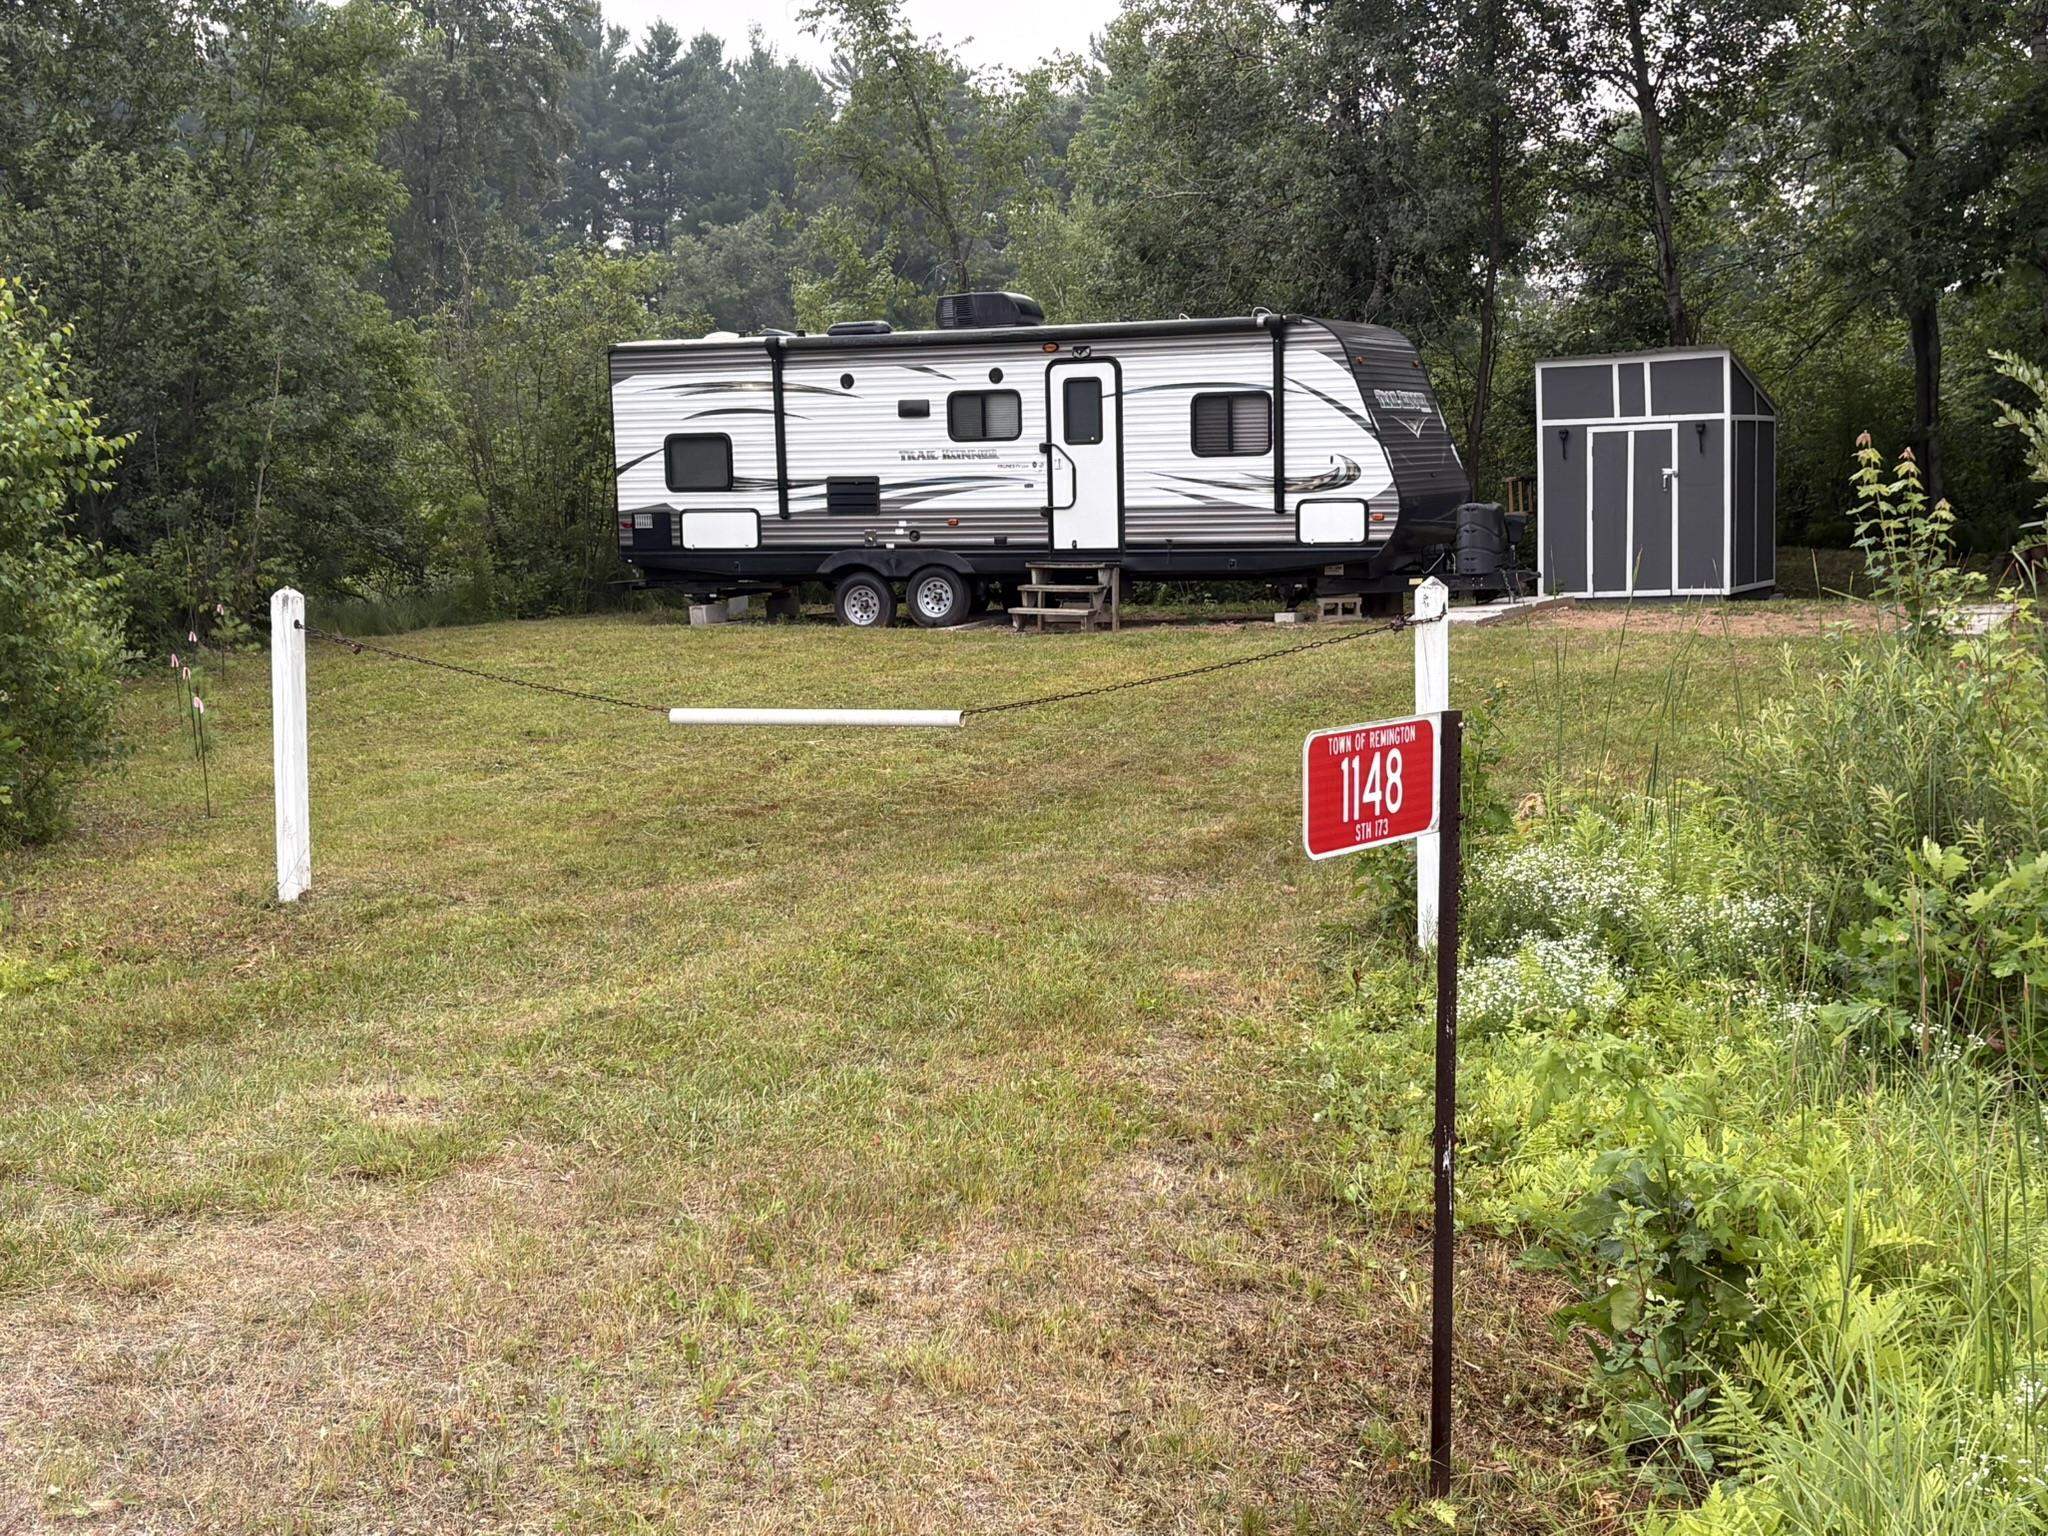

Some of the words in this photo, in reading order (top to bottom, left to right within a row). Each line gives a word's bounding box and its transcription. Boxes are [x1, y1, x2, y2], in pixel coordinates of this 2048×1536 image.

[1328, 736, 1351, 755] TOWN
[1355, 734, 1366, 751] OF
[1369, 725, 1415, 748] REMINGTON
[1341, 748, 1403, 822] 1148
[1355, 823, 1372, 841] STH
[1375, 819, 1388, 837] 173
